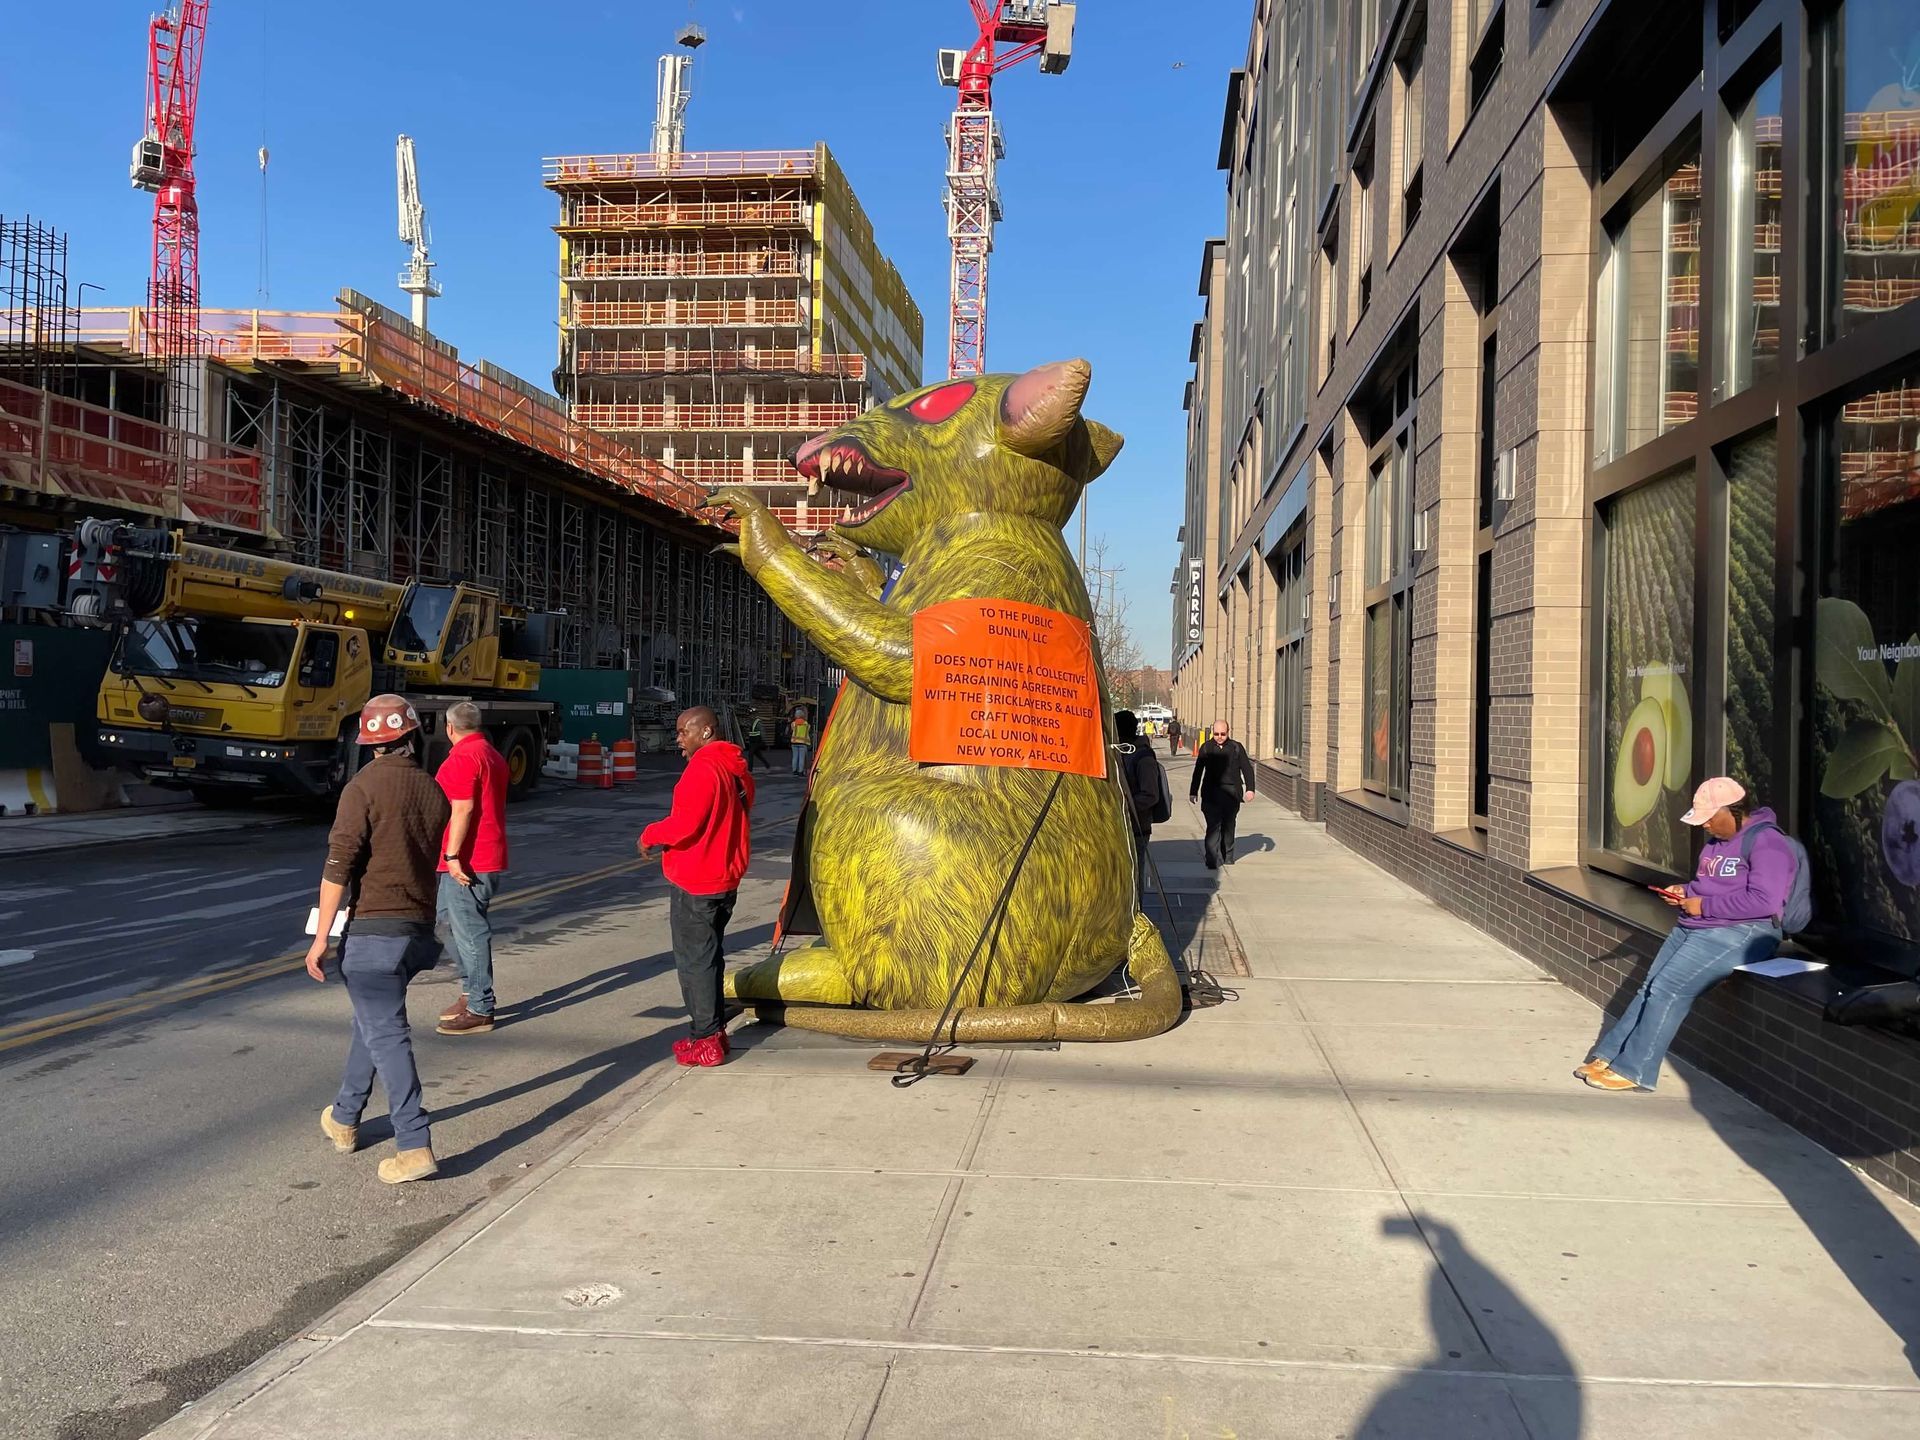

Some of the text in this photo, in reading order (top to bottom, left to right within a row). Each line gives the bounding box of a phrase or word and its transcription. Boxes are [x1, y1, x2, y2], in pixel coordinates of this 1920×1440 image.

[183, 549, 265, 577] CRANES
[1191, 571, 1200, 625] PARK
[979, 608, 1053, 629] TO THE PUBLIC
[988, 624, 1048, 644] BUNLIN, LLC
[1857, 645, 1878, 661] Your
[934, 654, 1086, 685] DOES NOT HAVE A COLLECTIVE
[945, 673, 1078, 699] BARGAINING AGREEMENT
[925, 689, 1093, 719] WITH THE BRICKLAYERS & ALLIED
[168, 709, 207, 721] GROVE
[971, 710, 1060, 729] CRAFT WORKERS
[960, 727, 1069, 749] LOCAL UNION No. 1,
[957, 745, 986, 756] NEW
[990, 747, 1025, 760] YORK,
